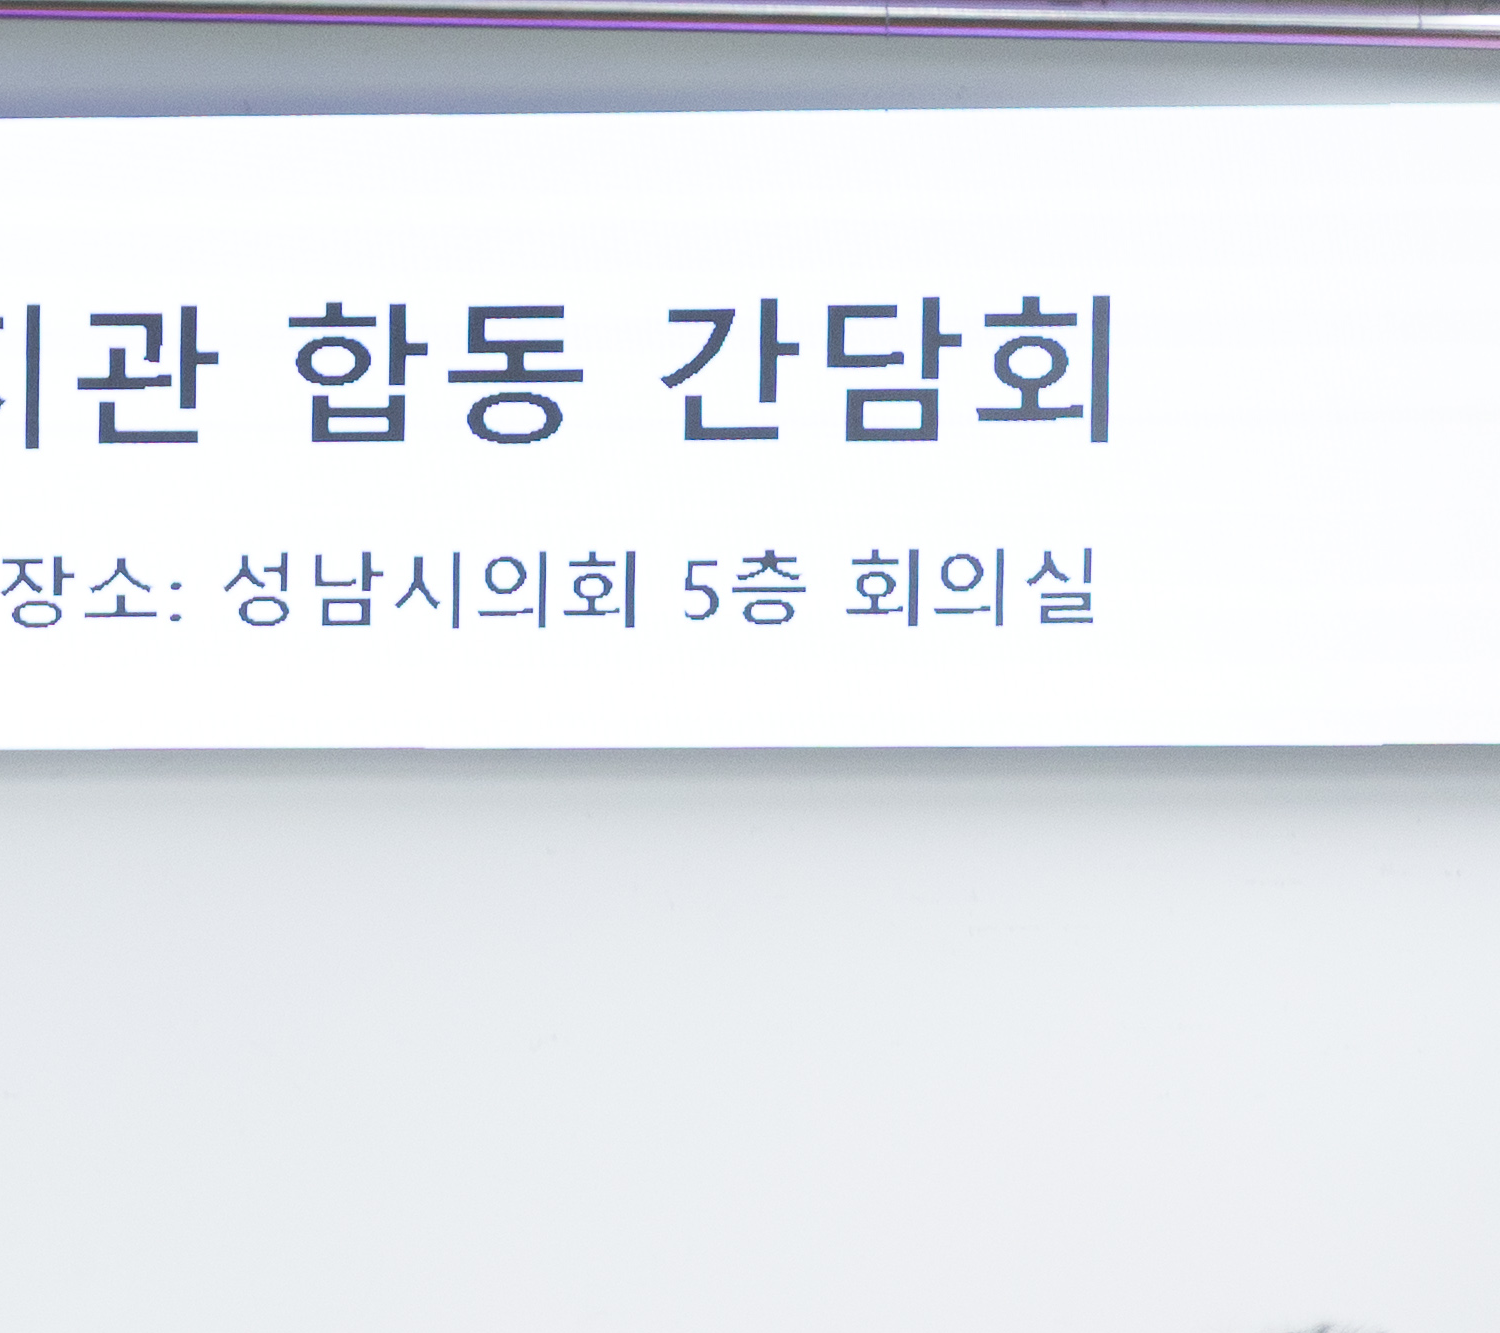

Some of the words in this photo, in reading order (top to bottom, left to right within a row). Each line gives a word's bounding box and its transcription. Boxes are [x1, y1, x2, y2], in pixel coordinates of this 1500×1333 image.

[288, 301, 584, 445] 합동
[660, 295, 1111, 444] 간담회
[0, 555, 183, 629] 장소:
[223, 550, 637, 630] 성남시의회
[684, 548, 807, 626] 5층
[845, 547, 1094, 628] 회의실
